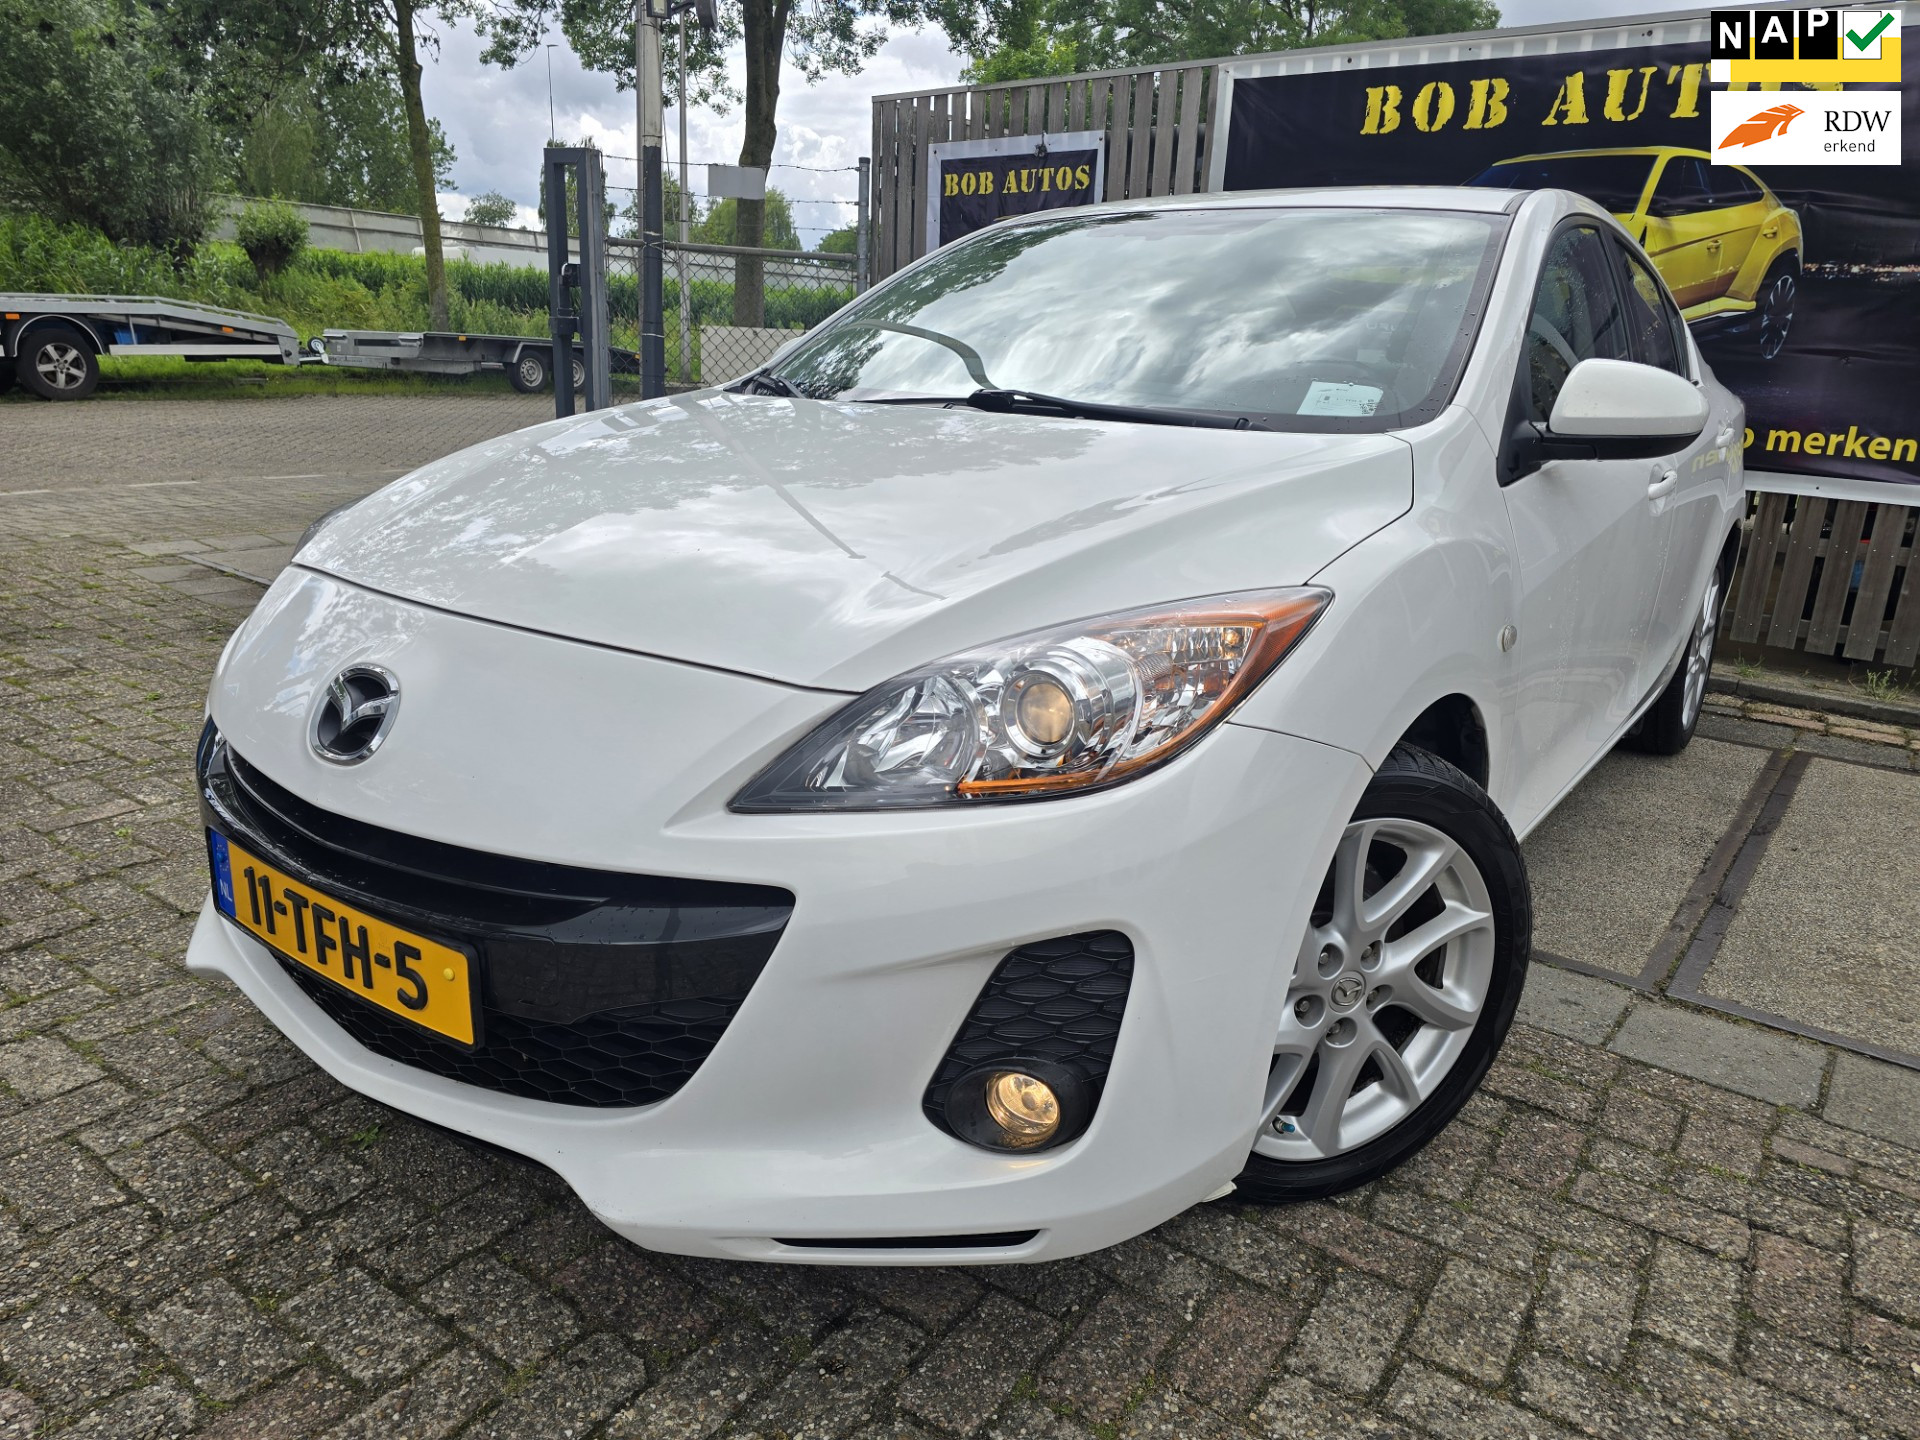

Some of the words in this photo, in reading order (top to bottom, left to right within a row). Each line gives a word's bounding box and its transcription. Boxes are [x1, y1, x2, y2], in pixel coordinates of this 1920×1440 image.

[1360, 78, 1510, 135] BOB
[1542, 63, 1844, 127] AUT
[944, 171, 994, 197] BOB
[1002, 164, 1090, 194] AUTOS
[1765, 426, 1919, 462] merken
[243, 866, 429, 1011] 11-TFH-5
